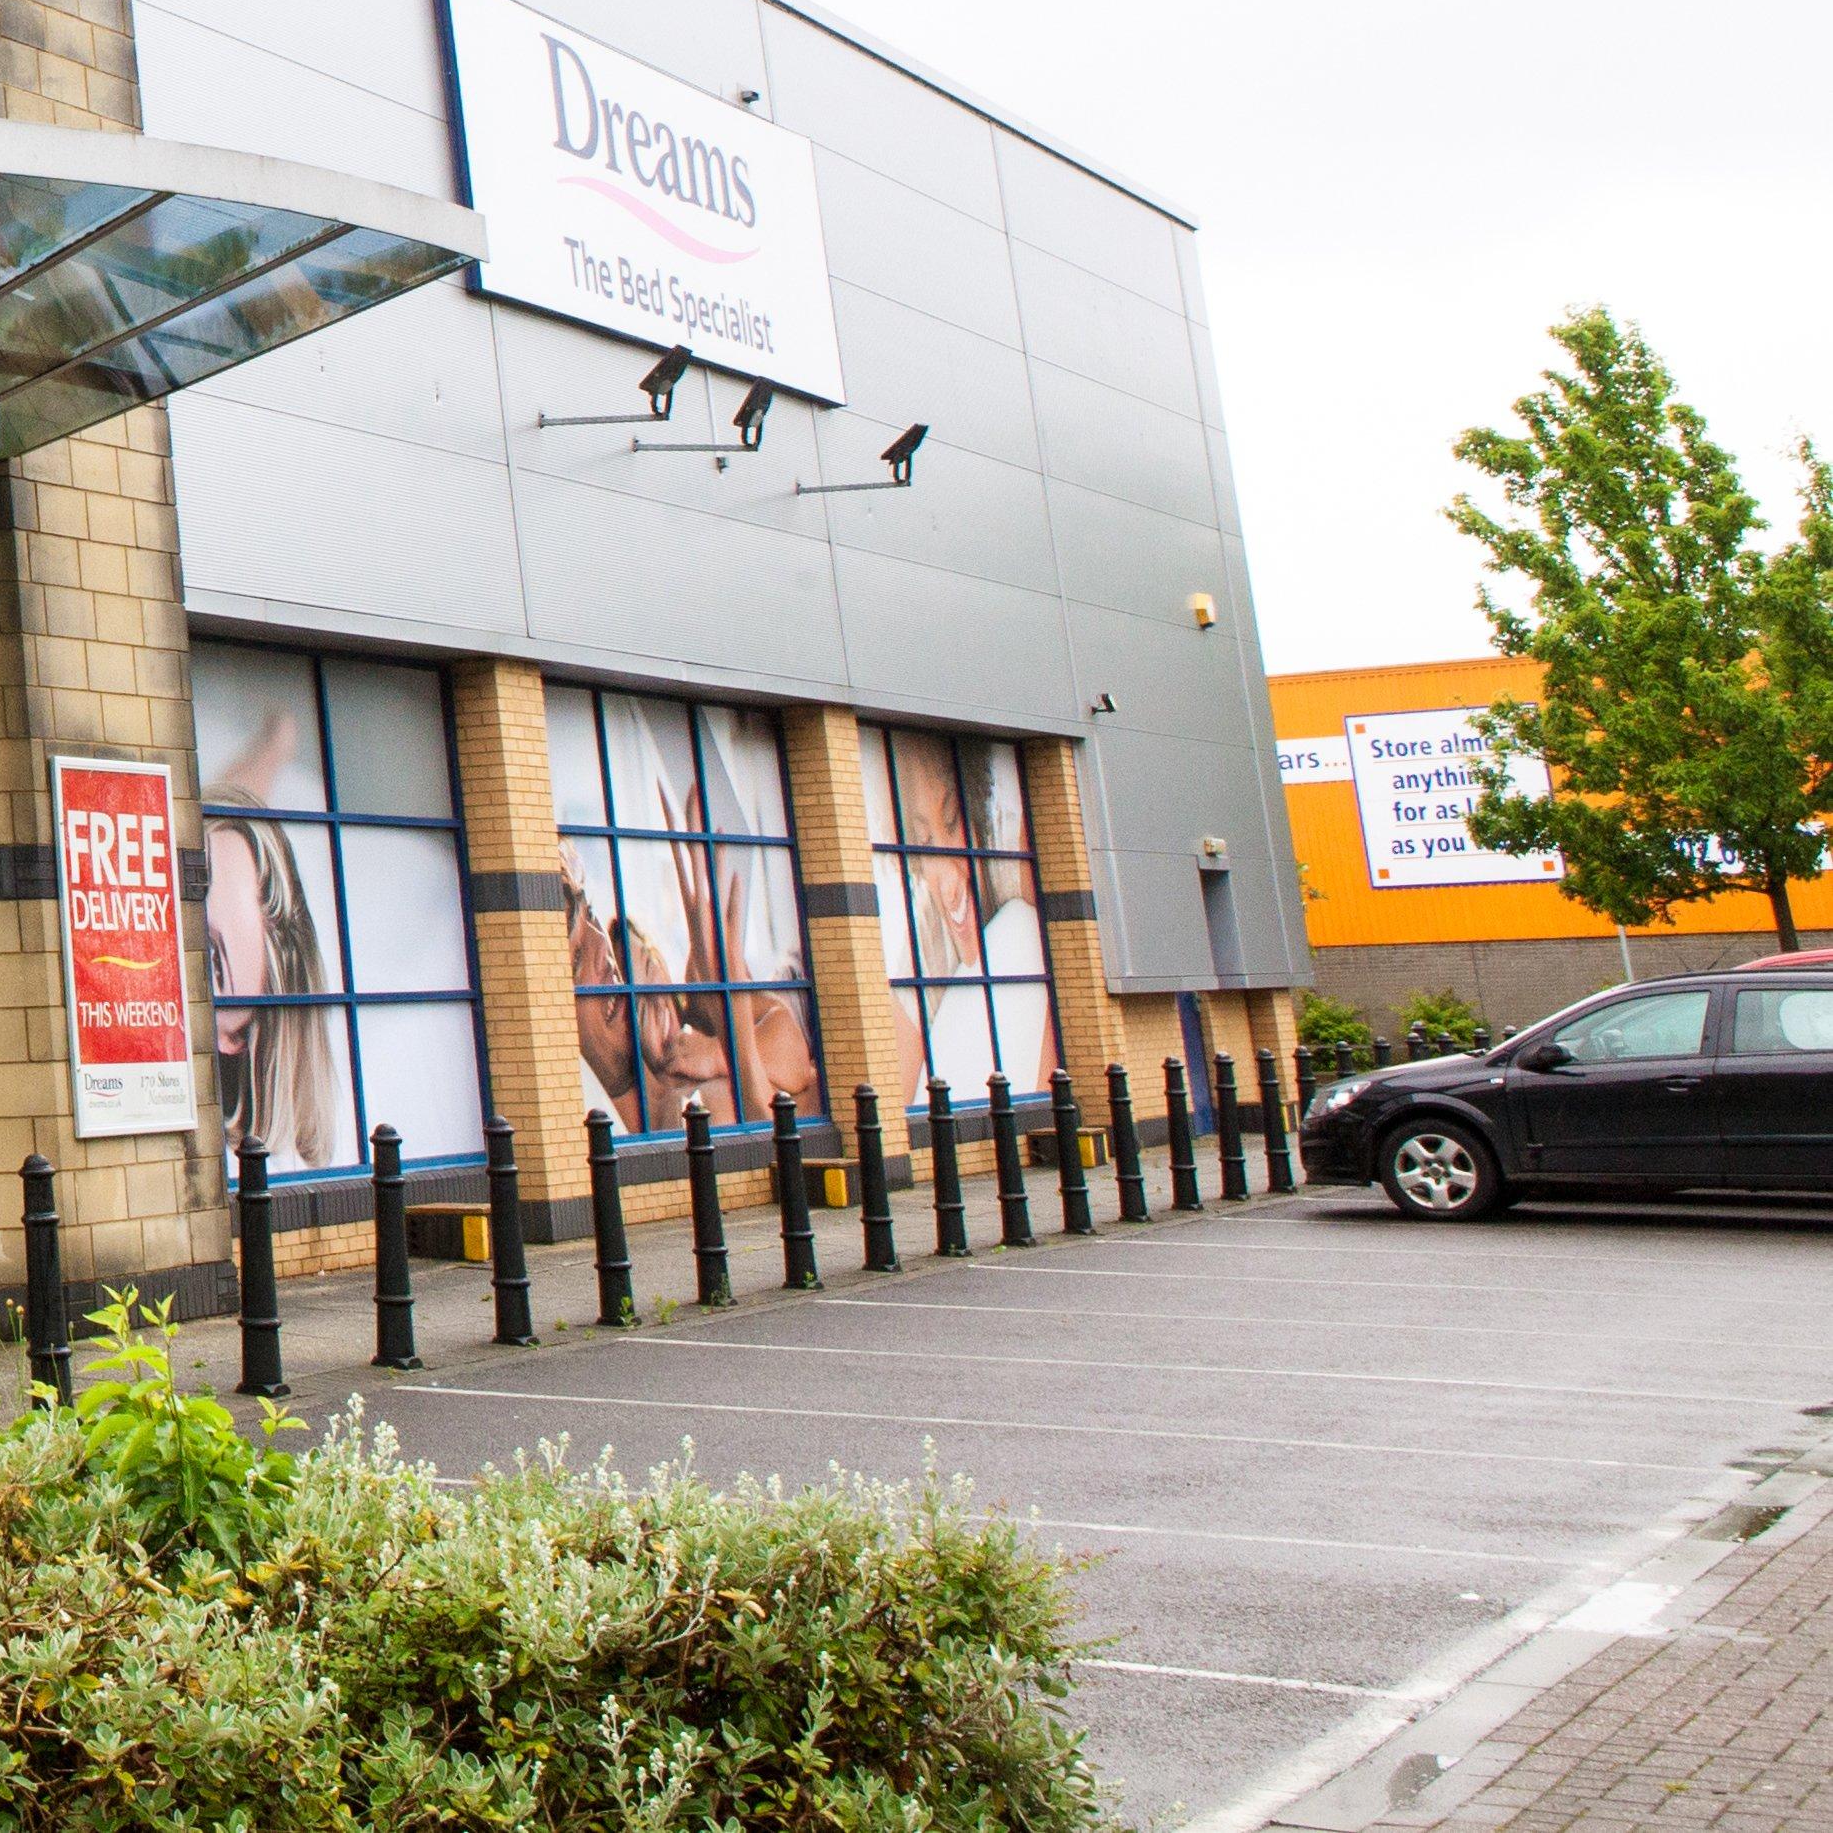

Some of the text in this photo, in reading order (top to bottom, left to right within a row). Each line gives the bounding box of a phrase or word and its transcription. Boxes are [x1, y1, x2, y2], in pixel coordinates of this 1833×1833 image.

[540, 32, 757, 228] Dreams
[564, 236, 774, 354] The Bed Specialist
[1371, 738, 1432, 758] Store
[1393, 801, 1427, 822] for
[1436, 804, 1459, 820] as
[67, 809, 167, 888] FREE
[1391, 838, 1415, 855] as
[1422, 836, 1465, 859] you
[72, 890, 170, 932] DELIVERY
[78, 1001, 178, 1028] THIS WEEKEND
[84, 1073, 124, 1091] Dreams
